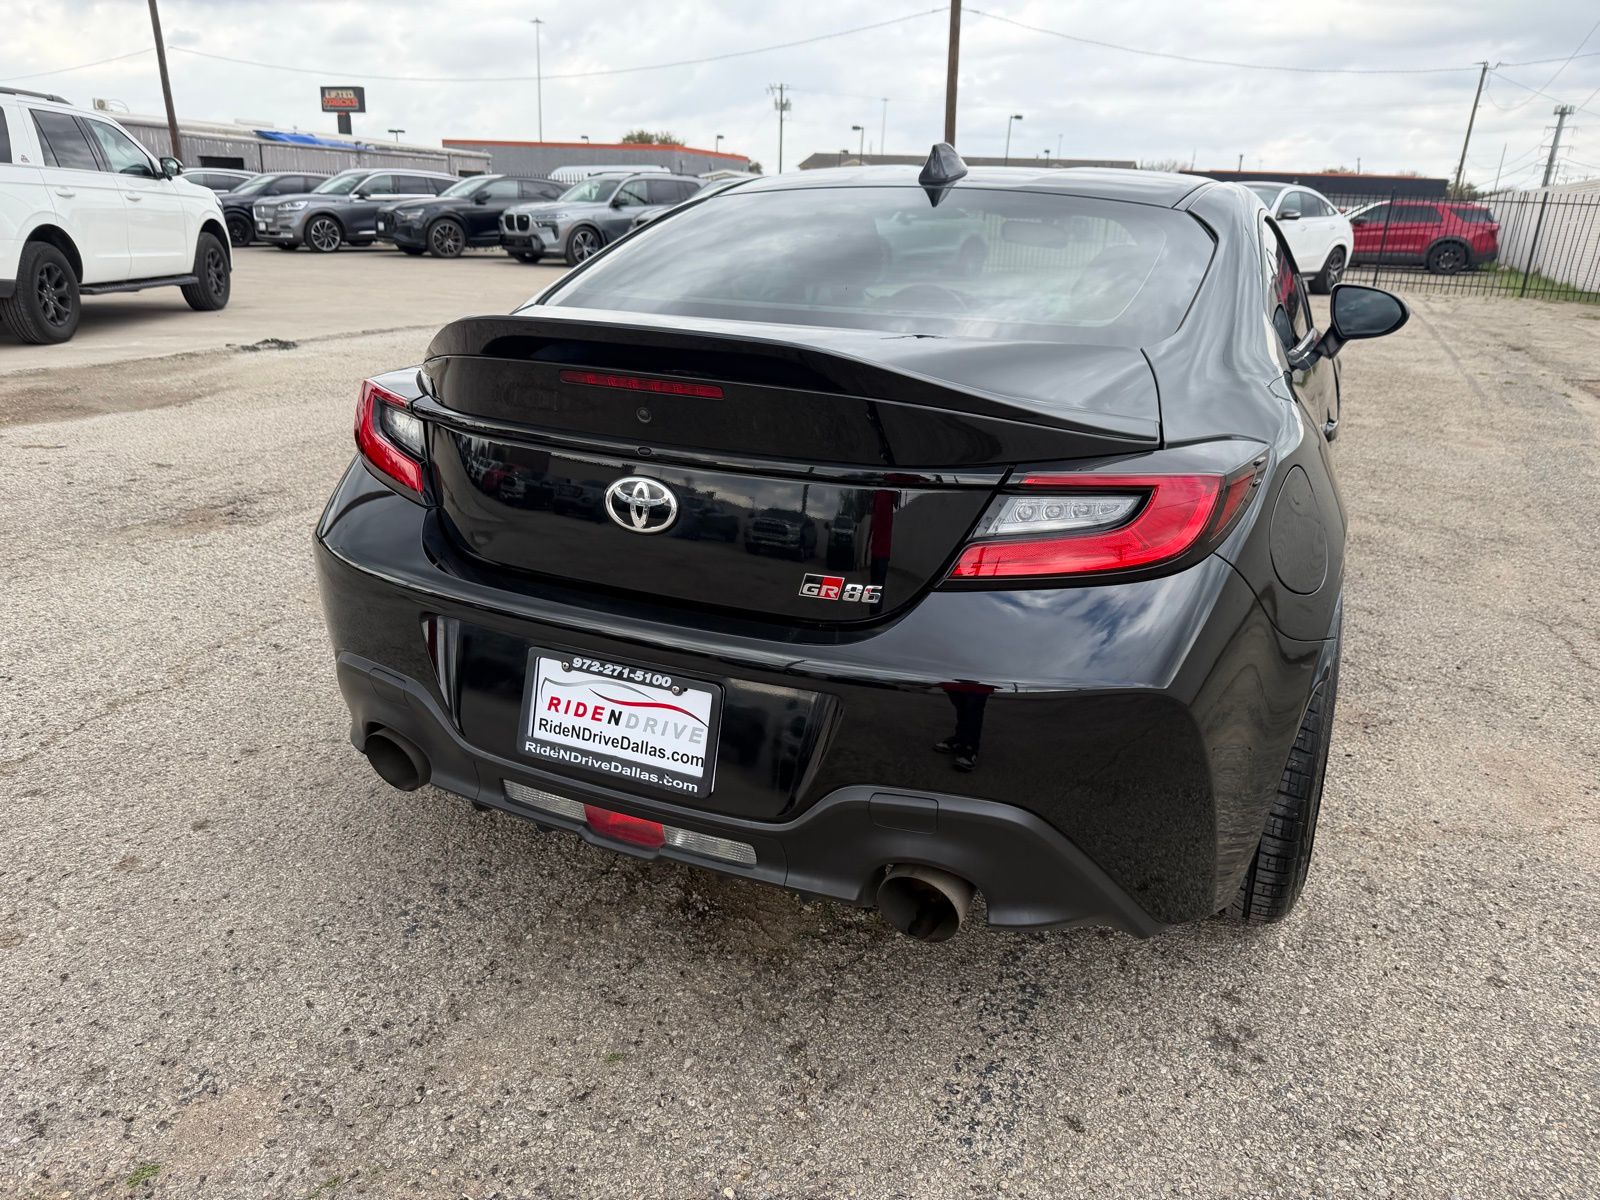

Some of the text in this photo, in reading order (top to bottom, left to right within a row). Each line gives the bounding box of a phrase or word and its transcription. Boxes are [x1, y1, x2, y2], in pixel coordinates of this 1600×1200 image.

[572, 657, 672, 688] 972-271-5100
[524, 740, 699, 793] RideNDriveDallas.com
[538, 717, 705, 768] RideNDriveDallas.com
